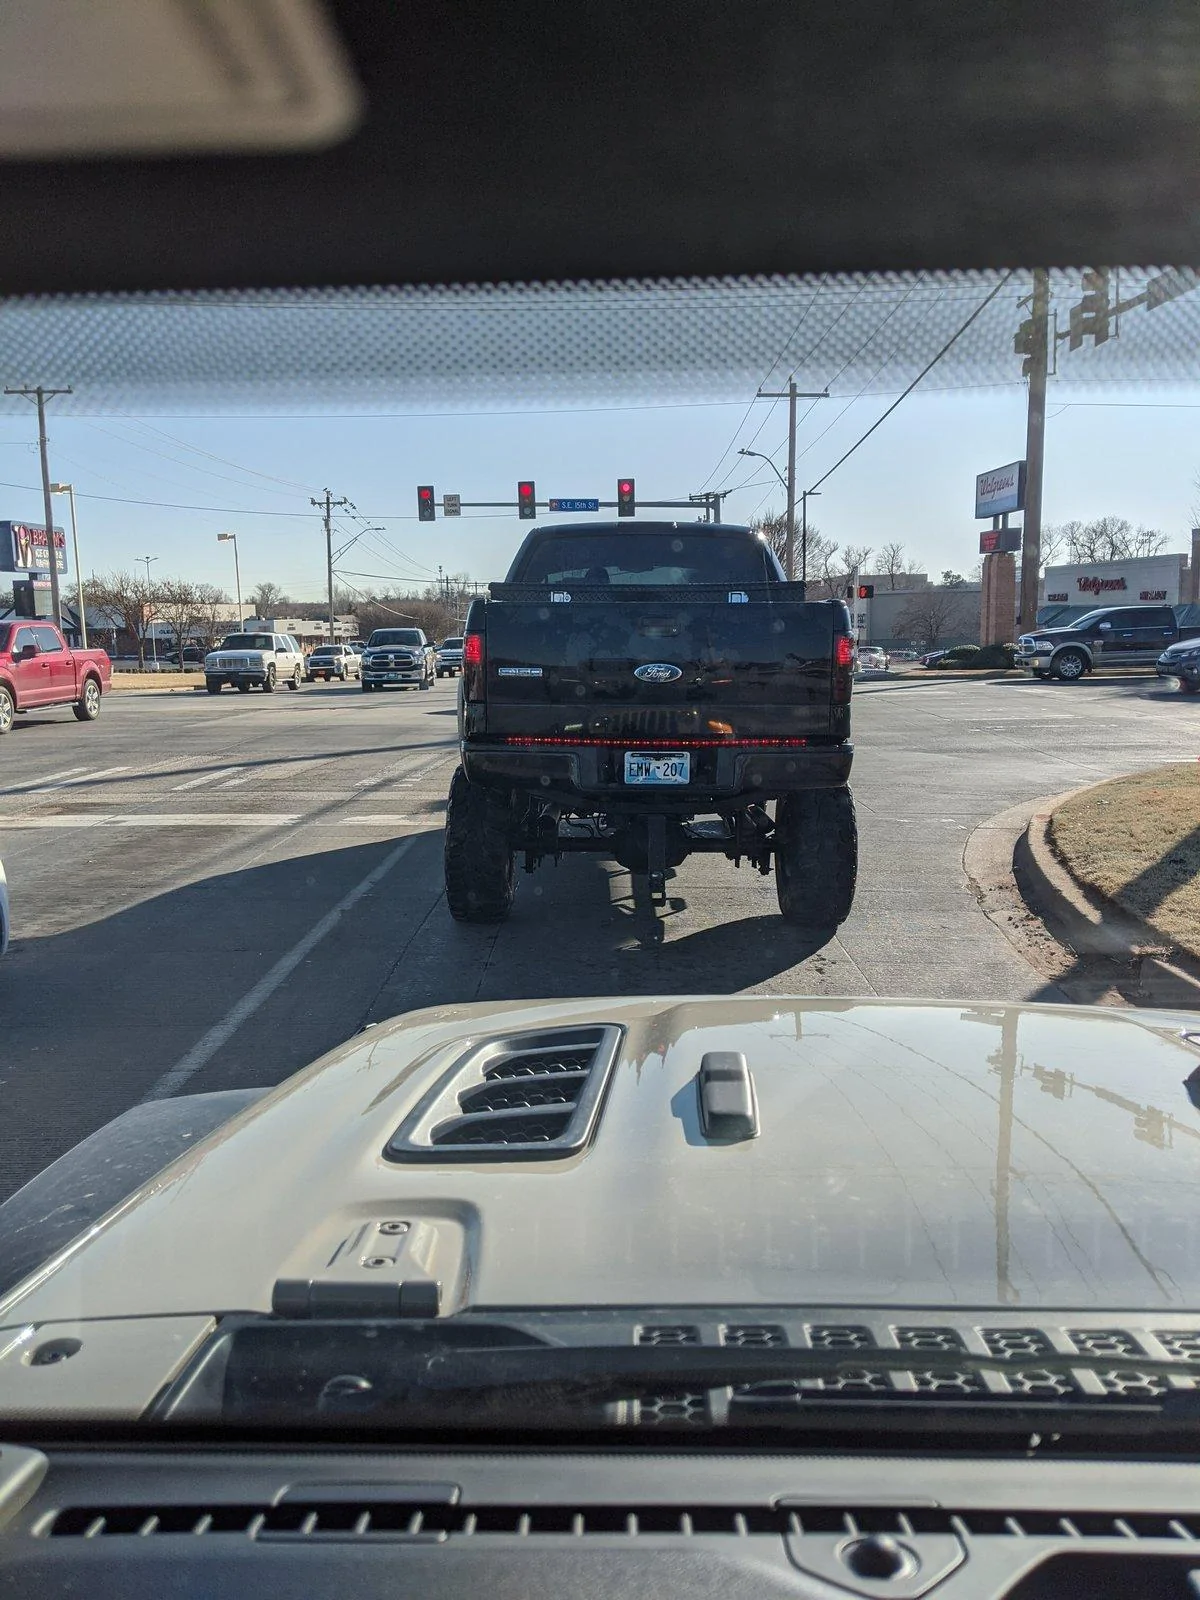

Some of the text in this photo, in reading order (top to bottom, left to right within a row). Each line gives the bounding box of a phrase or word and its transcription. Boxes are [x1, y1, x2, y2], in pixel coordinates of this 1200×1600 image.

[980, 475, 1014, 499] Walgreens
[575, 501, 587, 509] 15th
[645, 666, 671, 678] Ford
[629, 763, 684, 777] EMW 207
